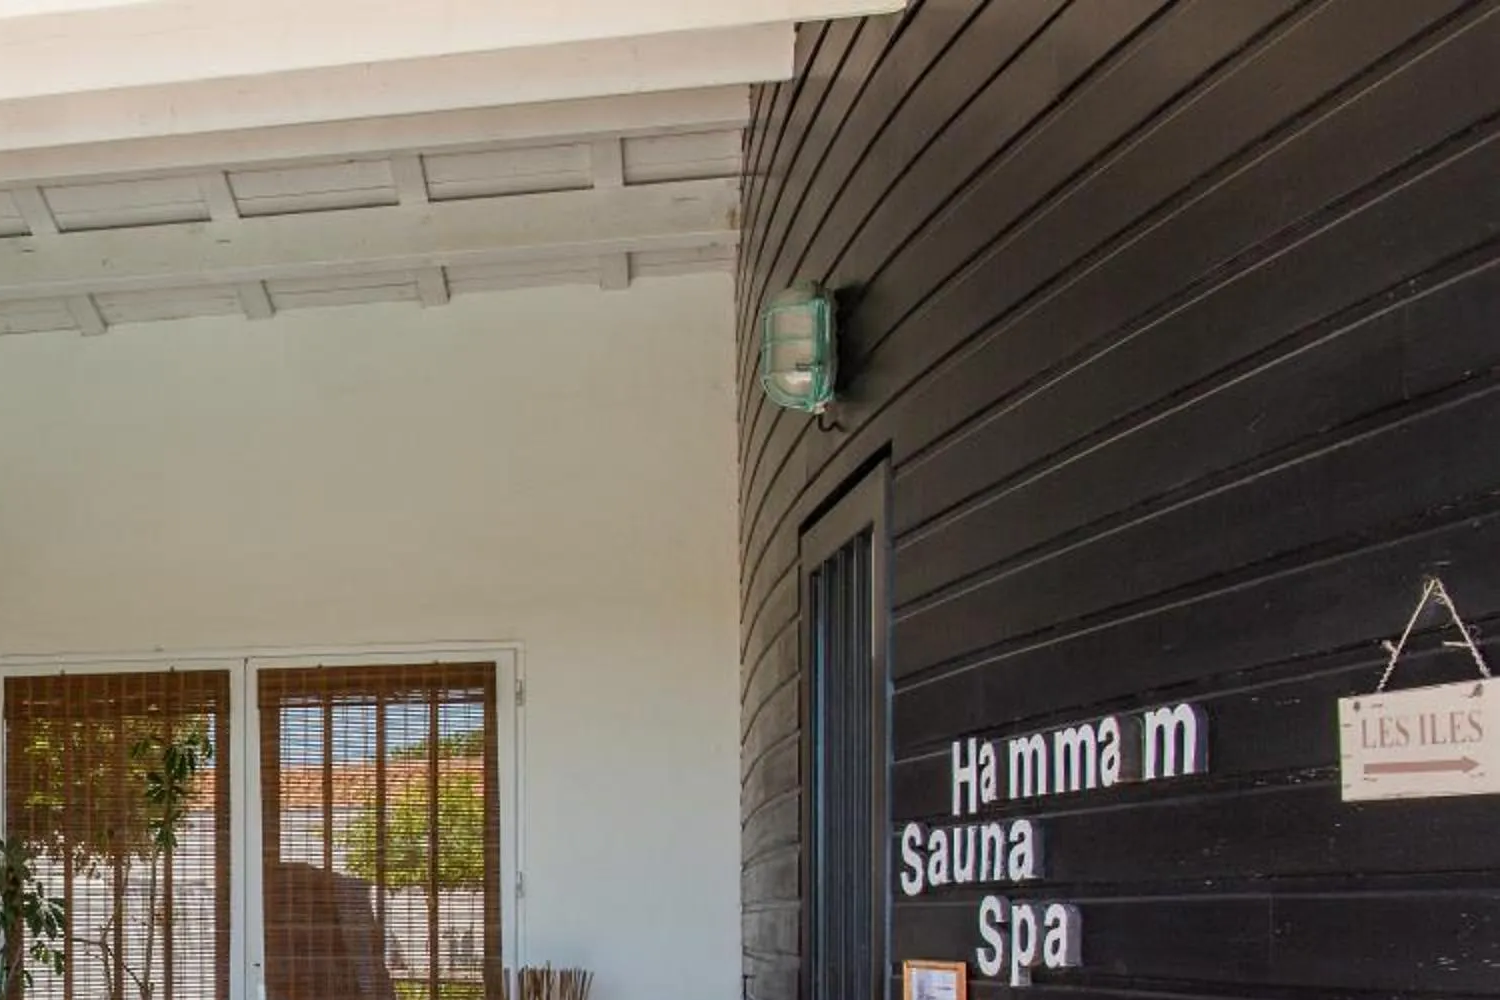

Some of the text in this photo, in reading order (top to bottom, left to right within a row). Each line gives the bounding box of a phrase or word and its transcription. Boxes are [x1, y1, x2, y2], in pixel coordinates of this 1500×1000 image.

[1361, 709, 1484, 750] LES ILES
[900, 818, 1041, 897] Sauna
[975, 894, 1076, 988] Spa
